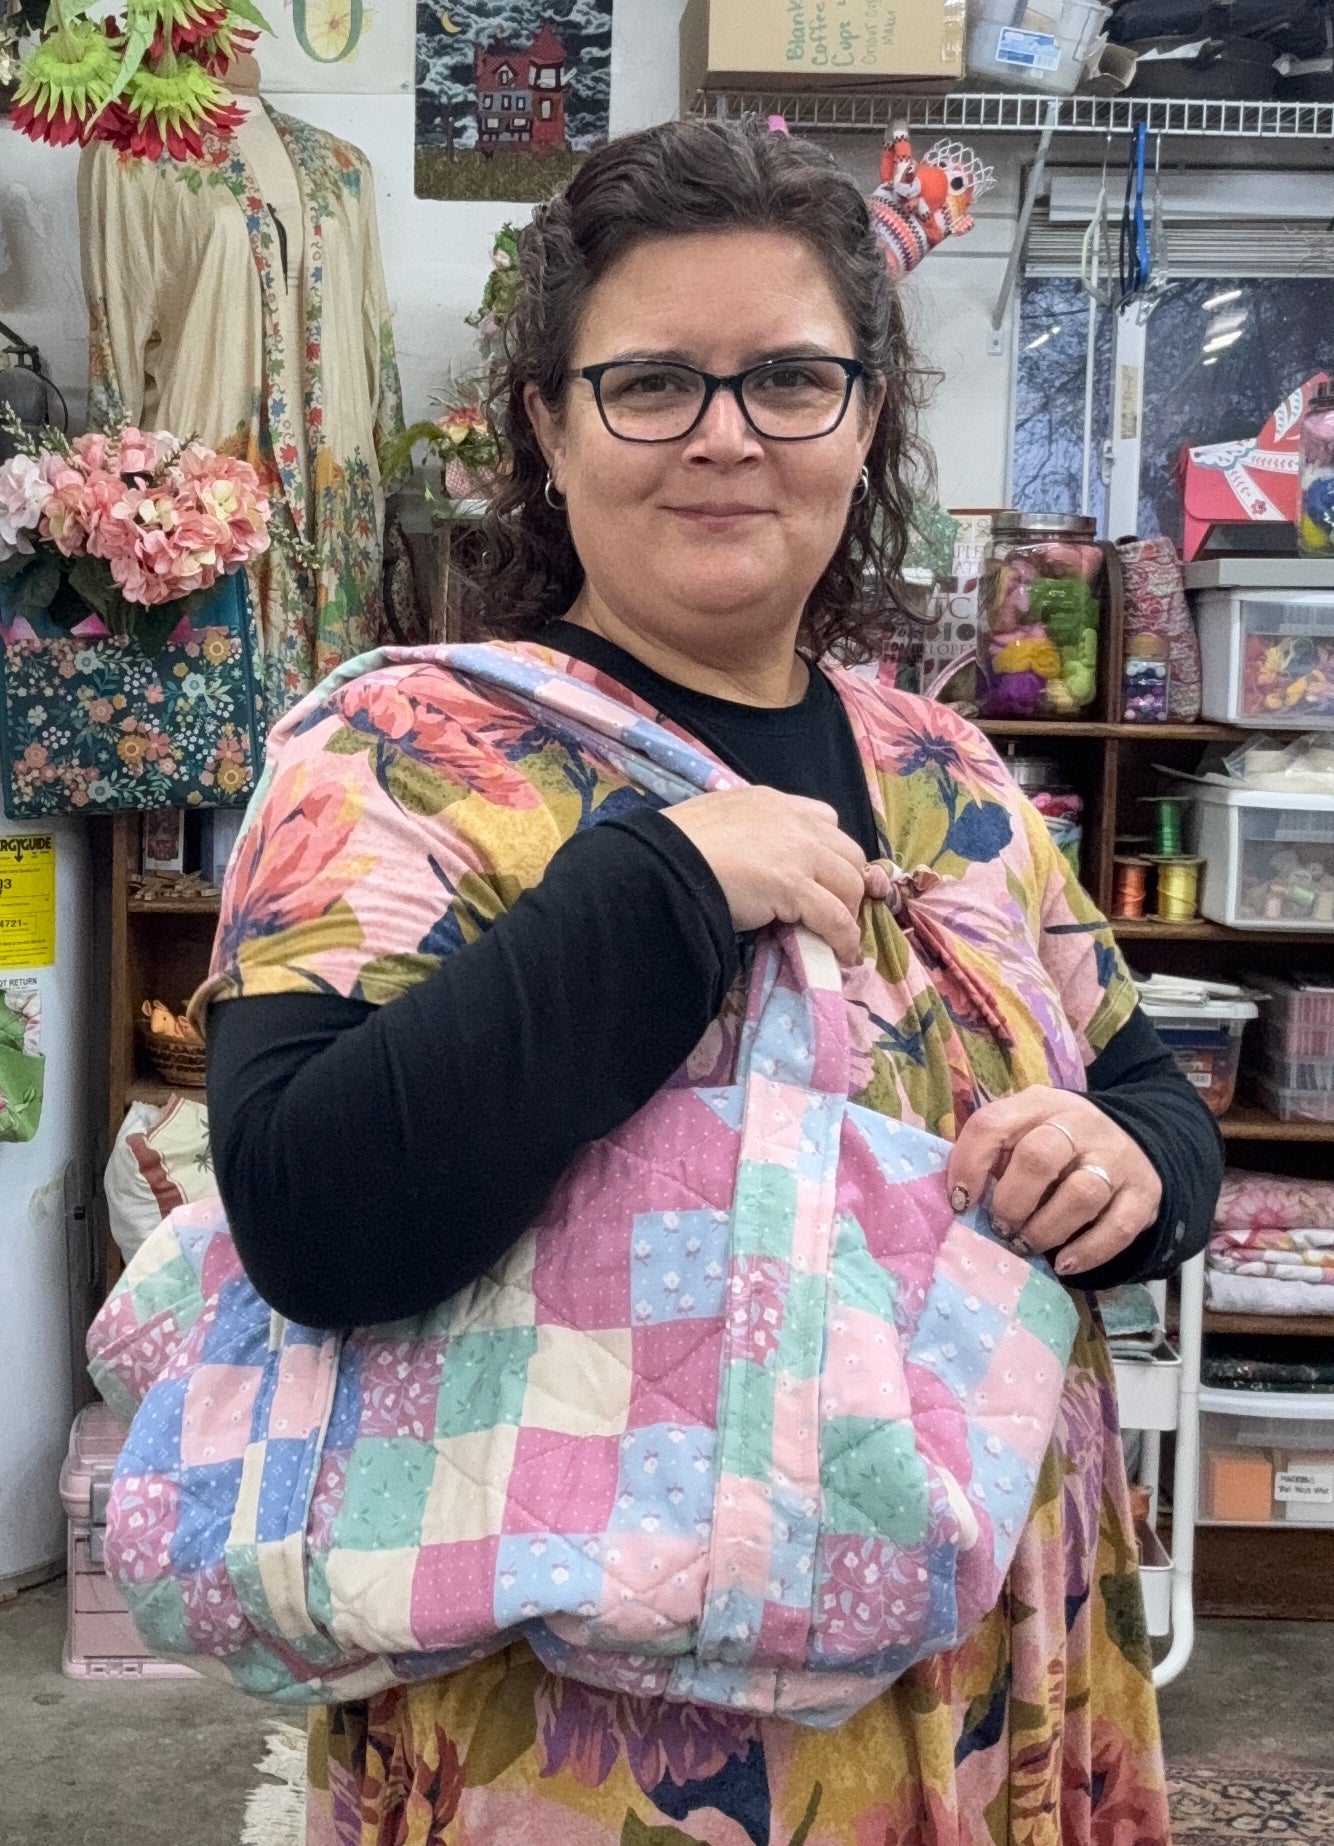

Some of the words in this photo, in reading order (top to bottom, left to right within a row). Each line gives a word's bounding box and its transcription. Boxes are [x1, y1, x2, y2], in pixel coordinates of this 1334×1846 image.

[786, 0, 805, 60] Blank
[809, 0, 829, 66] Coffee
[9, 977, 38, 987] RETURN
